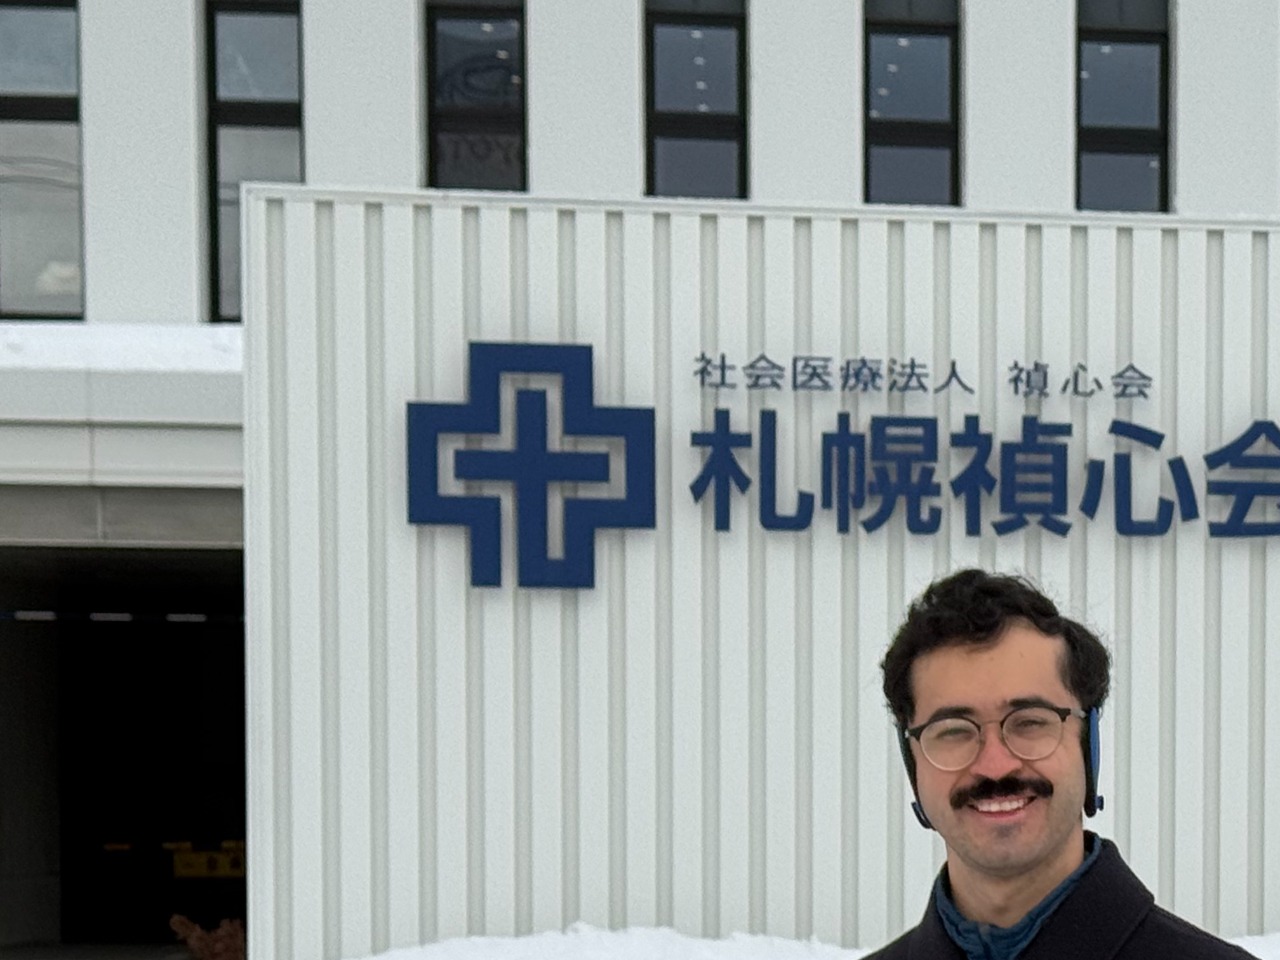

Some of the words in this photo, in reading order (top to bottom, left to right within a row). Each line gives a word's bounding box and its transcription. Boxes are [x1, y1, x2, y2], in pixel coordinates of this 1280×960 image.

[694, 353, 975, 392] 社会医療法人
[1009, 361, 1153, 398] 禎心会
